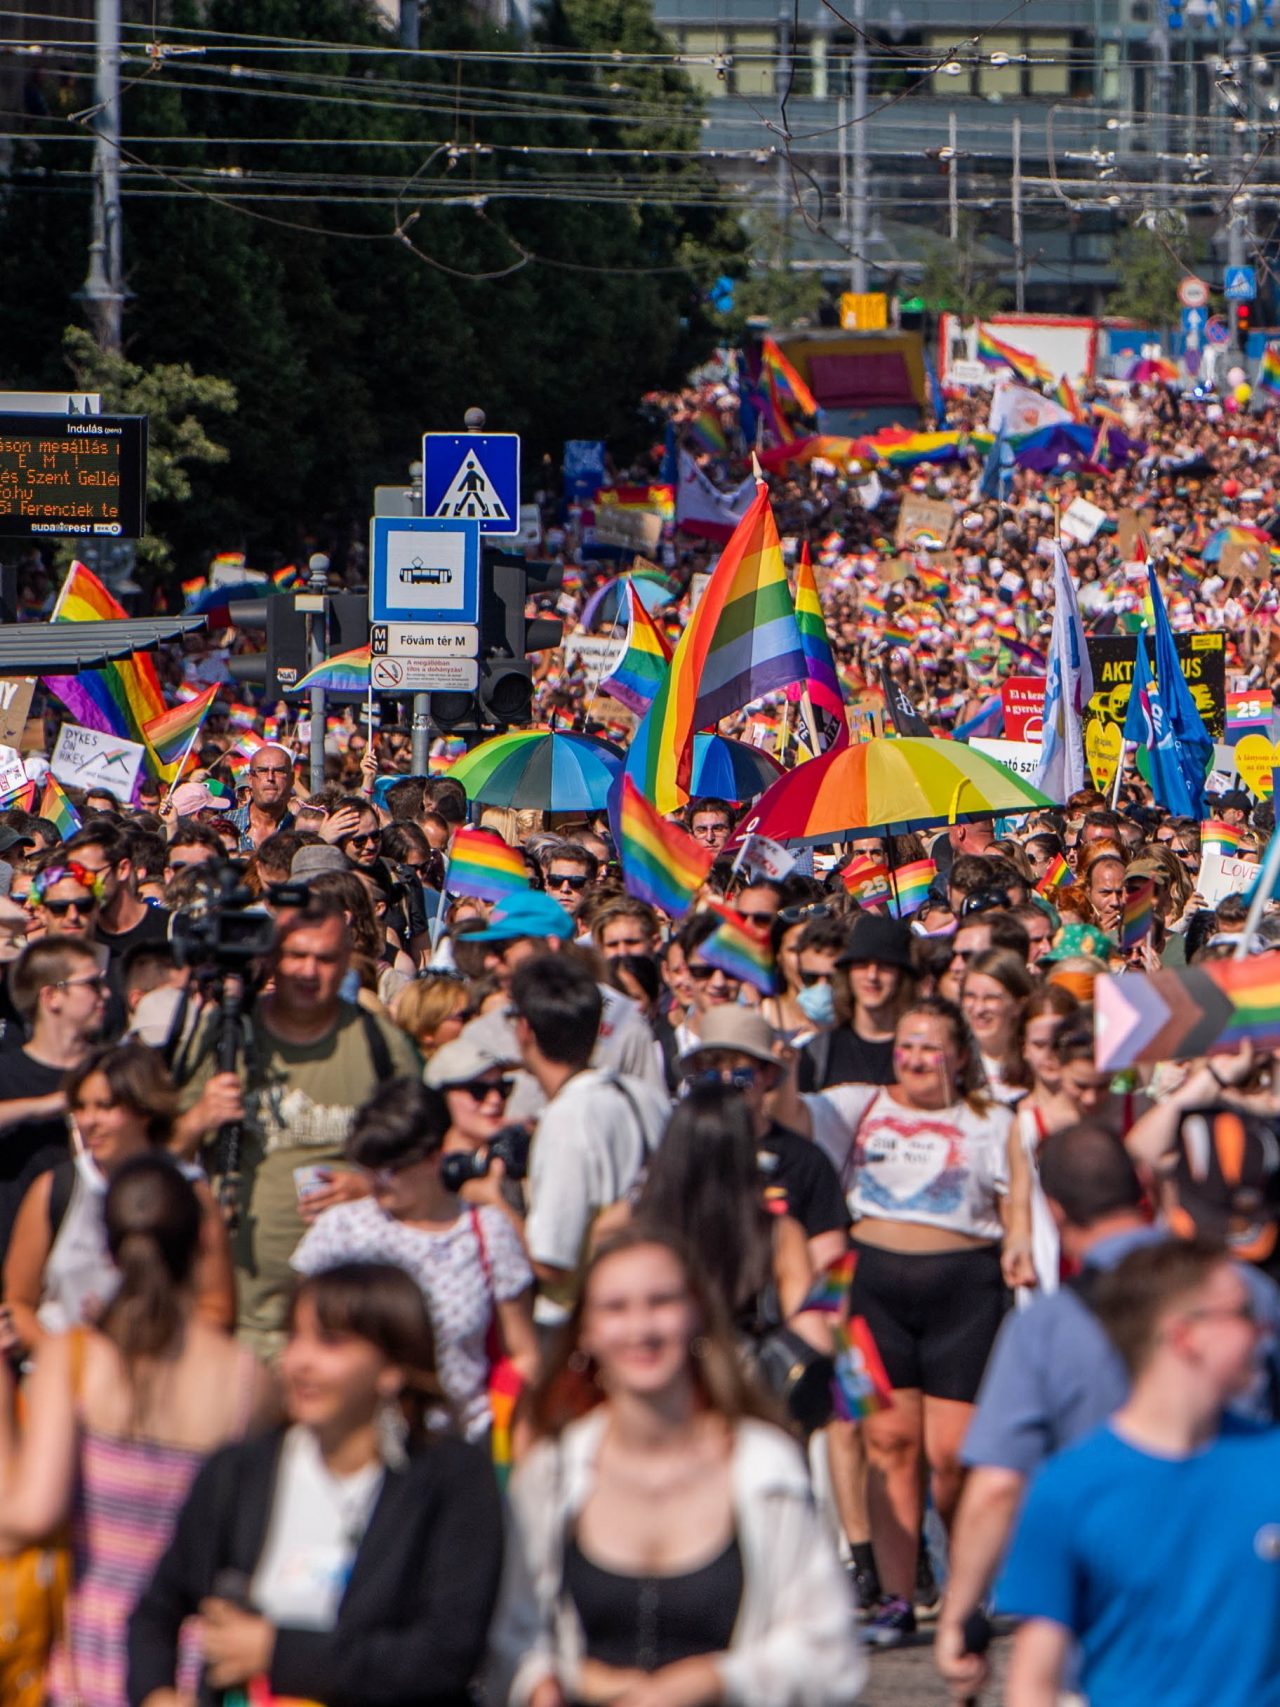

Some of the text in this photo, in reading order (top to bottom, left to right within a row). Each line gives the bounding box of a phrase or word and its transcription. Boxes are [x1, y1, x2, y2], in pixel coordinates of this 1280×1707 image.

[67, 424, 103, 434] Indulás
[39, 438, 108, 455] megállás
[18, 453, 27, 468] E
[43, 454, 56, 468] M
[27, 469, 70, 485] Szent
[20, 501, 94, 516] Ferenciek
[400, 634, 466, 646] Fővám tér M
[1236, 700, 1261, 719] 25
[65, 728, 98, 747] DYKES
[1220, 859, 1258, 880] LOVE
[861, 874, 889, 898] 25
